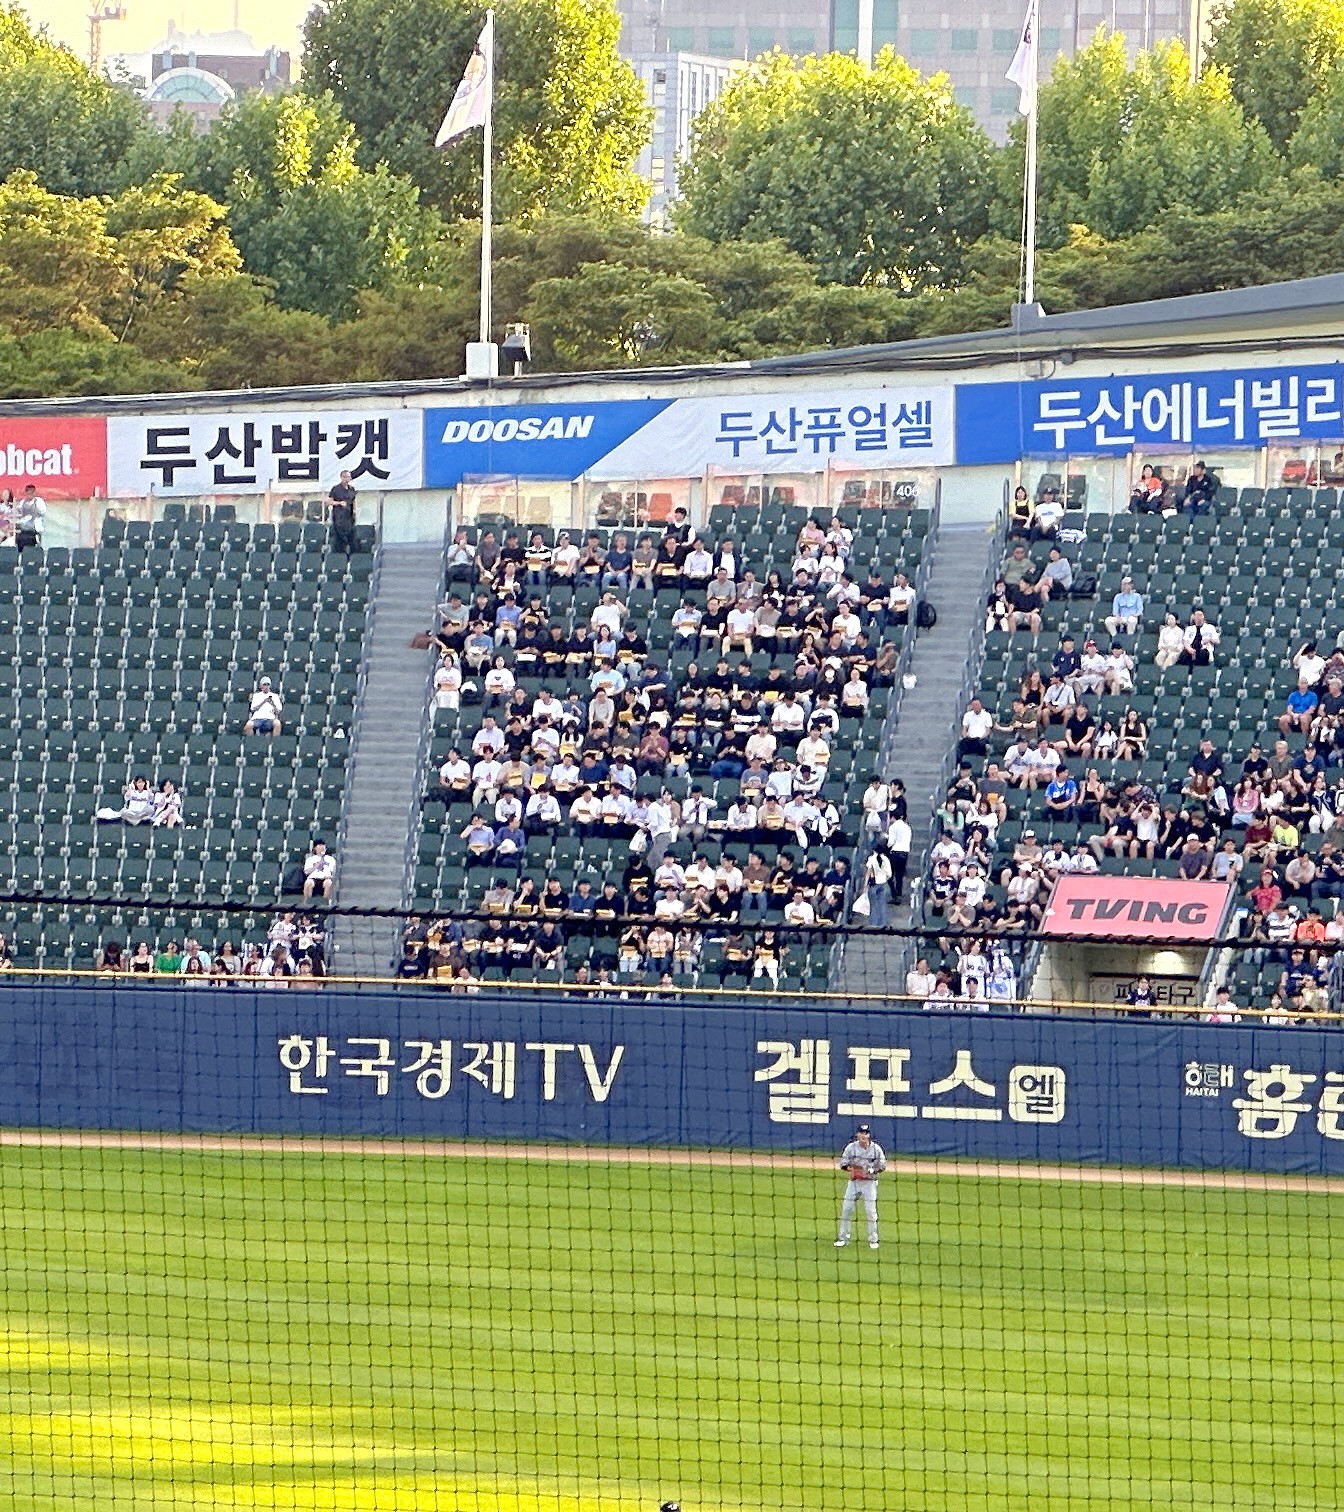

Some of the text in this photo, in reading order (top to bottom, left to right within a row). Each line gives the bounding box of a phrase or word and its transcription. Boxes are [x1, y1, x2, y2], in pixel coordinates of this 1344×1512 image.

[441, 415, 595, 444] DOOSAN
[715, 399, 933, 456] 두산퓨얼셀
[140, 418, 391, 487] 두산밥캣
[896, 484, 920, 498] 406
[1066, 898, 1209, 924] TVING
[1113, 982, 1196, 1007] 파타구
[277, 1034, 625, 1102] 한국경제TV
[1185, 1087, 1219, 1097] HAITAI
